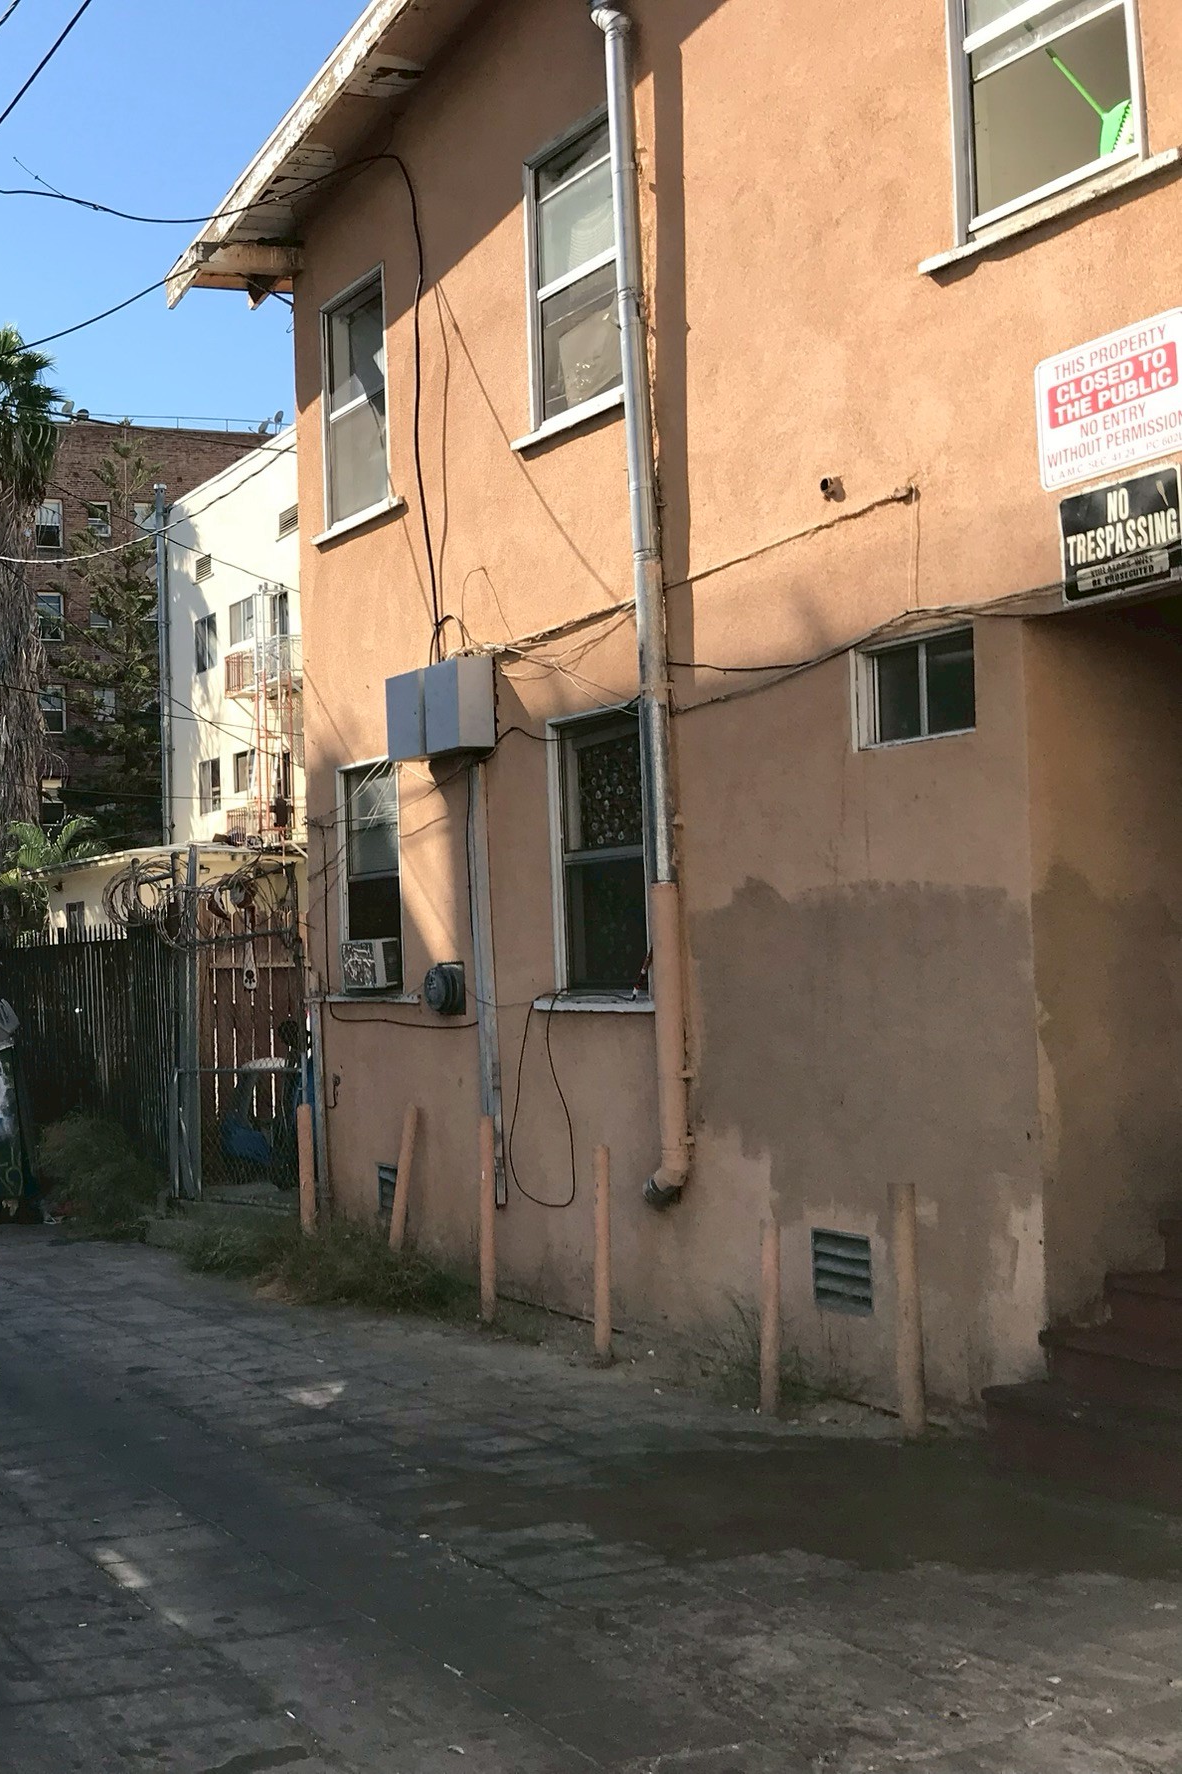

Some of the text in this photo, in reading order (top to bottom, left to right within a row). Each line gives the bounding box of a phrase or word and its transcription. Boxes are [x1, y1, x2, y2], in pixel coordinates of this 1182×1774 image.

[1054, 324, 1166, 380] THIS PROPERTY
[1056, 348, 1167, 404] CLOSED TO
[1054, 367, 1172, 424] THE PUBLIC
[1080, 402, 1146, 438] NO ENTRY
[1047, 438, 1102, 468] WITHOUT
[1107, 487, 1129, 523] NO
[1067, 508, 1178, 566] TRESPASSING
